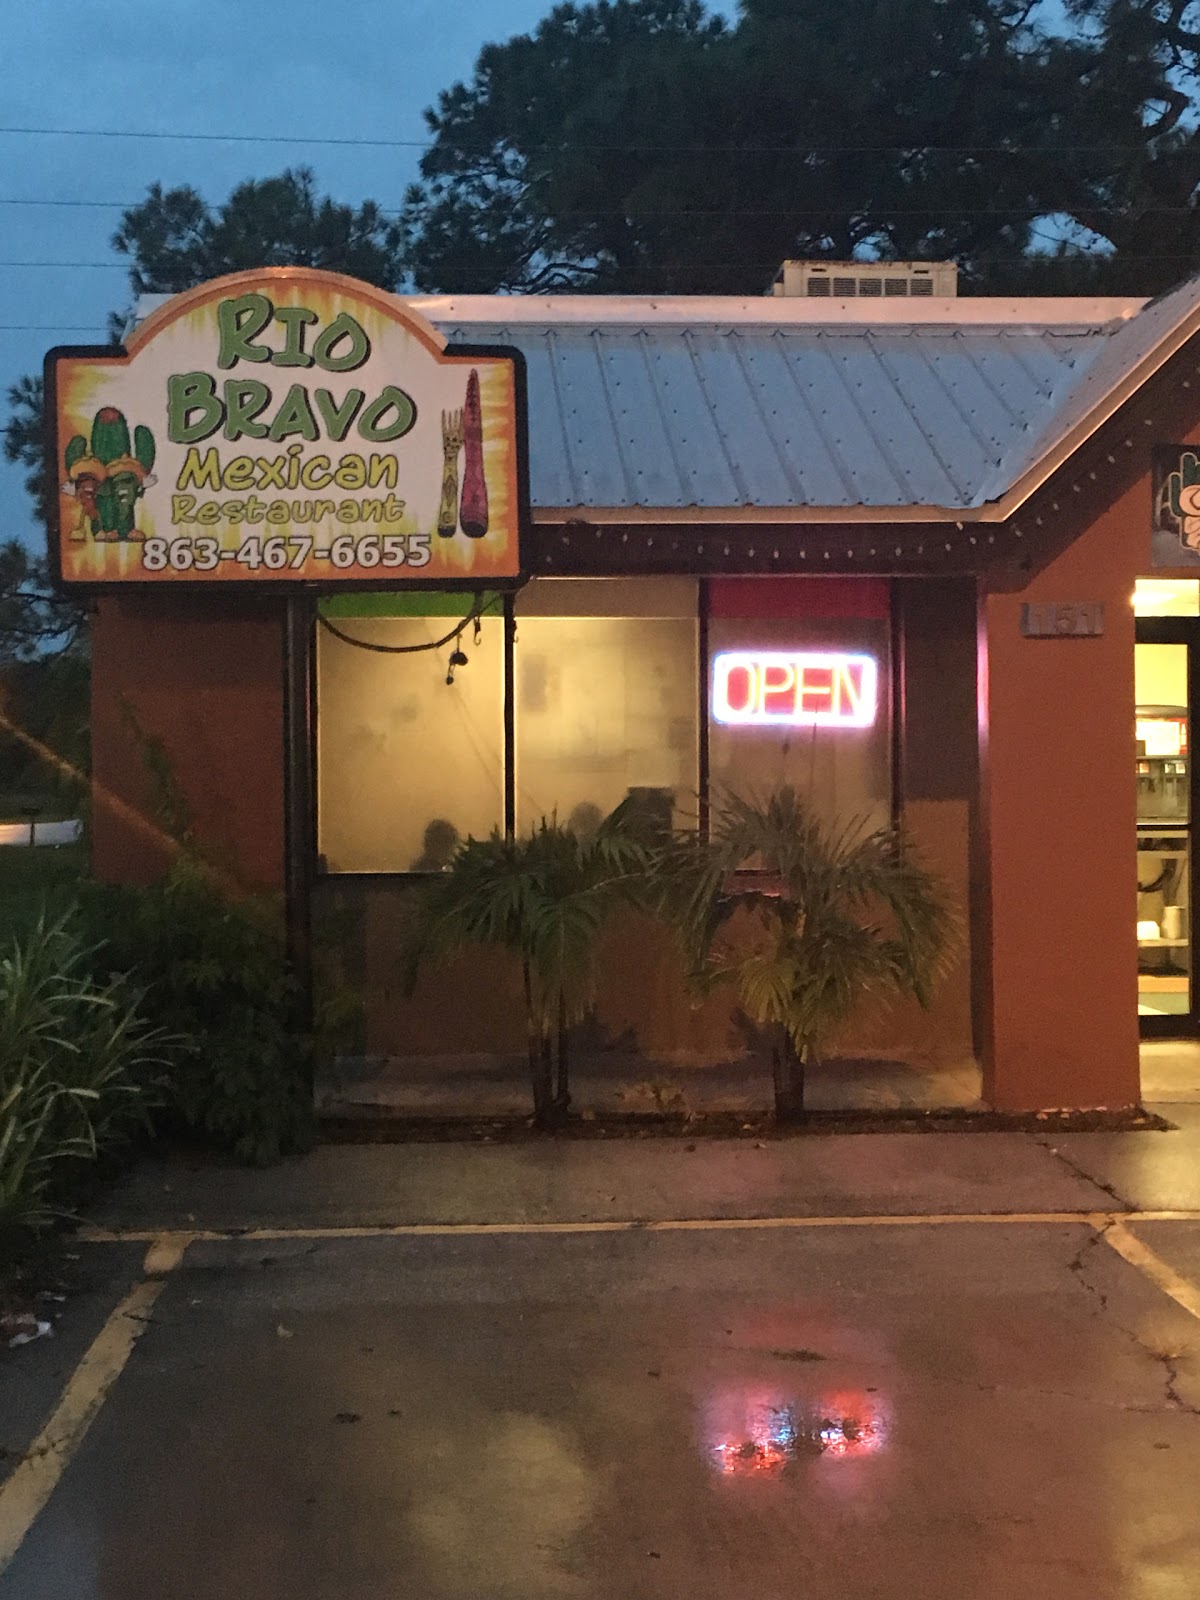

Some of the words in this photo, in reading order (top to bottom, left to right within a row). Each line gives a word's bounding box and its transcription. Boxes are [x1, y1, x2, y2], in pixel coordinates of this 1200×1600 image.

[219, 294, 372, 371] RIO
[167, 372, 417, 444] BRAVO
[177, 445, 399, 492] Mexican
[171, 494, 406, 525] Restaurant
[142, 534, 431, 570] 863-467-6655
[722, 661, 868, 719] OPEN
